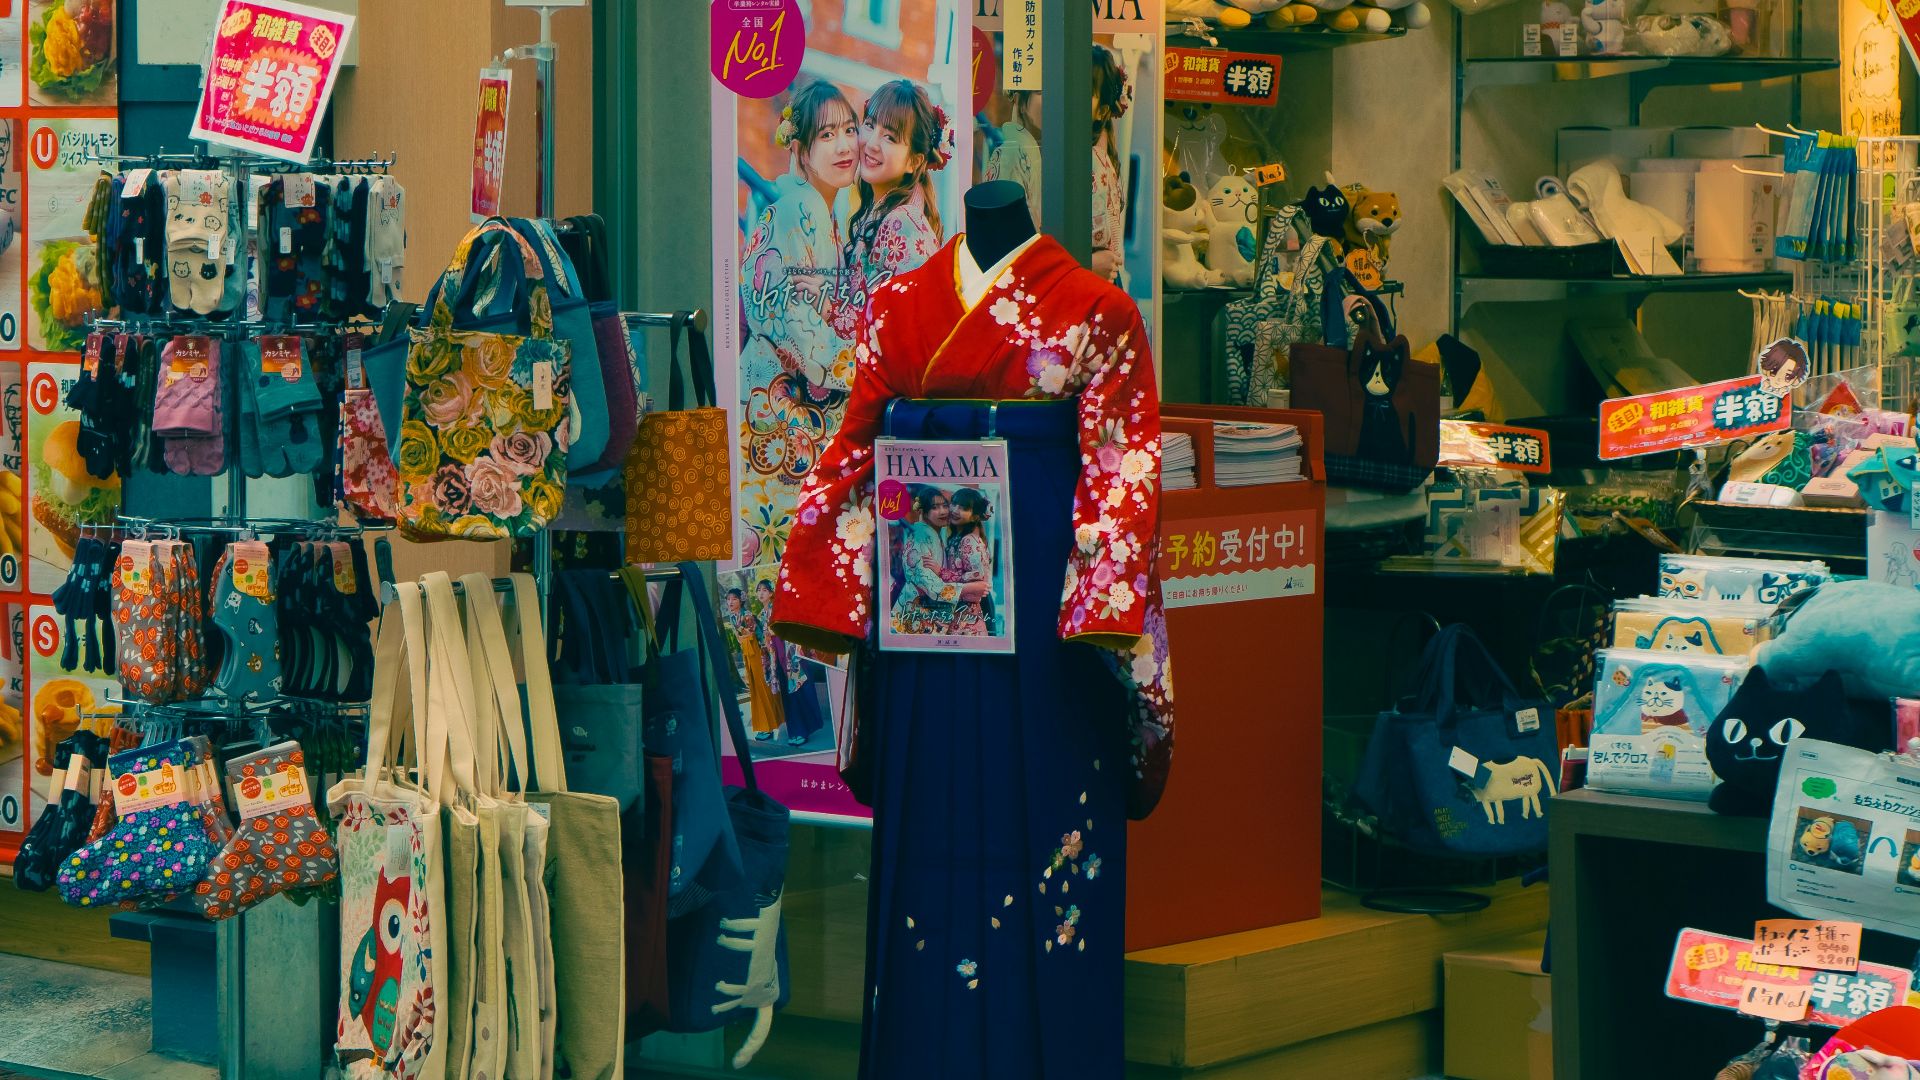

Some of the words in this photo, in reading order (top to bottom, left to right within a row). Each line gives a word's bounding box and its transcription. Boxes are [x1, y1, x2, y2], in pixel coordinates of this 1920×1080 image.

[252, 13, 303, 46] 和雑貨
[742, 17, 764, 28] 全国
[1026, 1, 1036, 67] 防犯カメラ
[723, 10, 786, 80] No.1
[1013, 48, 1023, 87] 作動中
[1183, 55, 1221, 74] 和雑貨
[242, 58, 318, 123] 半額
[1228, 65, 1273, 95] 半額
[36, 133, 53, 163] U
[61, 132, 117, 147] バジルレモン
[176, 349, 200, 358] カシミヤ
[264, 349, 290, 358] カシミヤ
[36, 378, 52, 408] C
[1610, 404, 1640, 430] 注目!
[1650, 395, 1704, 420] 和雑貨
[1715, 390, 1780, 427] 半額
[1488, 436, 1540, 463] 半額
[886, 454, 1000, 478] HAKAMA
[880, 491, 902, 515] No.1
[1166, 523, 1305, 571] 予約受付中!
[38, 621, 53, 651] S
[1593, 750, 1649, 765] 包んでクロス
[800, 778, 851, 792] はかまレン
[1813, 975, 1893, 1015] 半額
